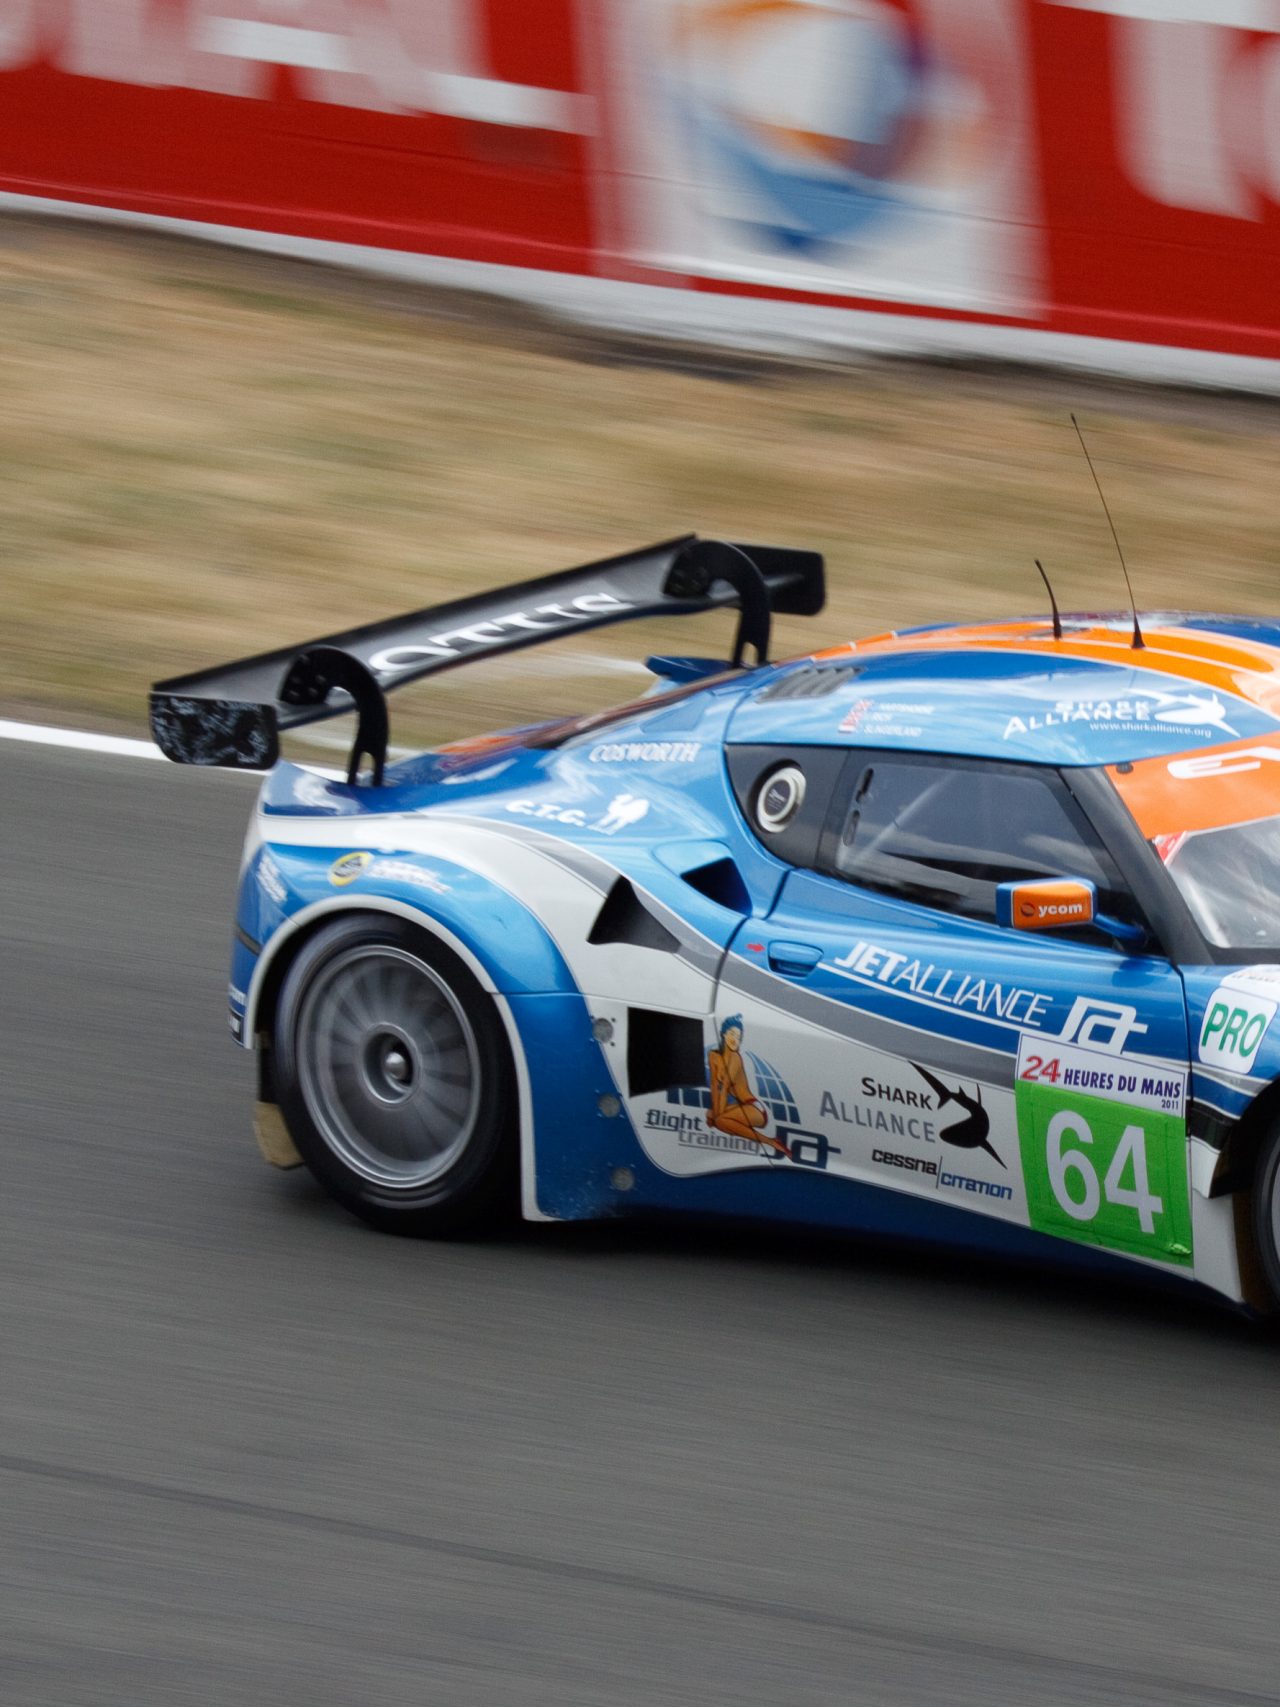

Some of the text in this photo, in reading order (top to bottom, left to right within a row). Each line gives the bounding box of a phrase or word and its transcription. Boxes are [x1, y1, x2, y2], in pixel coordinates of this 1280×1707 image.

[1002, 707, 1151, 740] ALLIANCE
[1089, 721, 1212, 739] www.sharkalliance.org
[589, 742, 701, 763] COSWORTH
[1038, 903, 1083, 918] ycom
[1201, 1002, 1267, 1057] PRO
[1020, 1055, 1182, 1099] 24 HEURES DU MANS
[861, 1076, 934, 1111] SHARK
[1161, 1099, 1179, 1110] 2011
[645, 1108, 704, 1132] flight
[819, 1090, 937, 1144] ALLIANCE
[678, 1129, 760, 1152] training
[1045, 1109, 1163, 1234] 64
